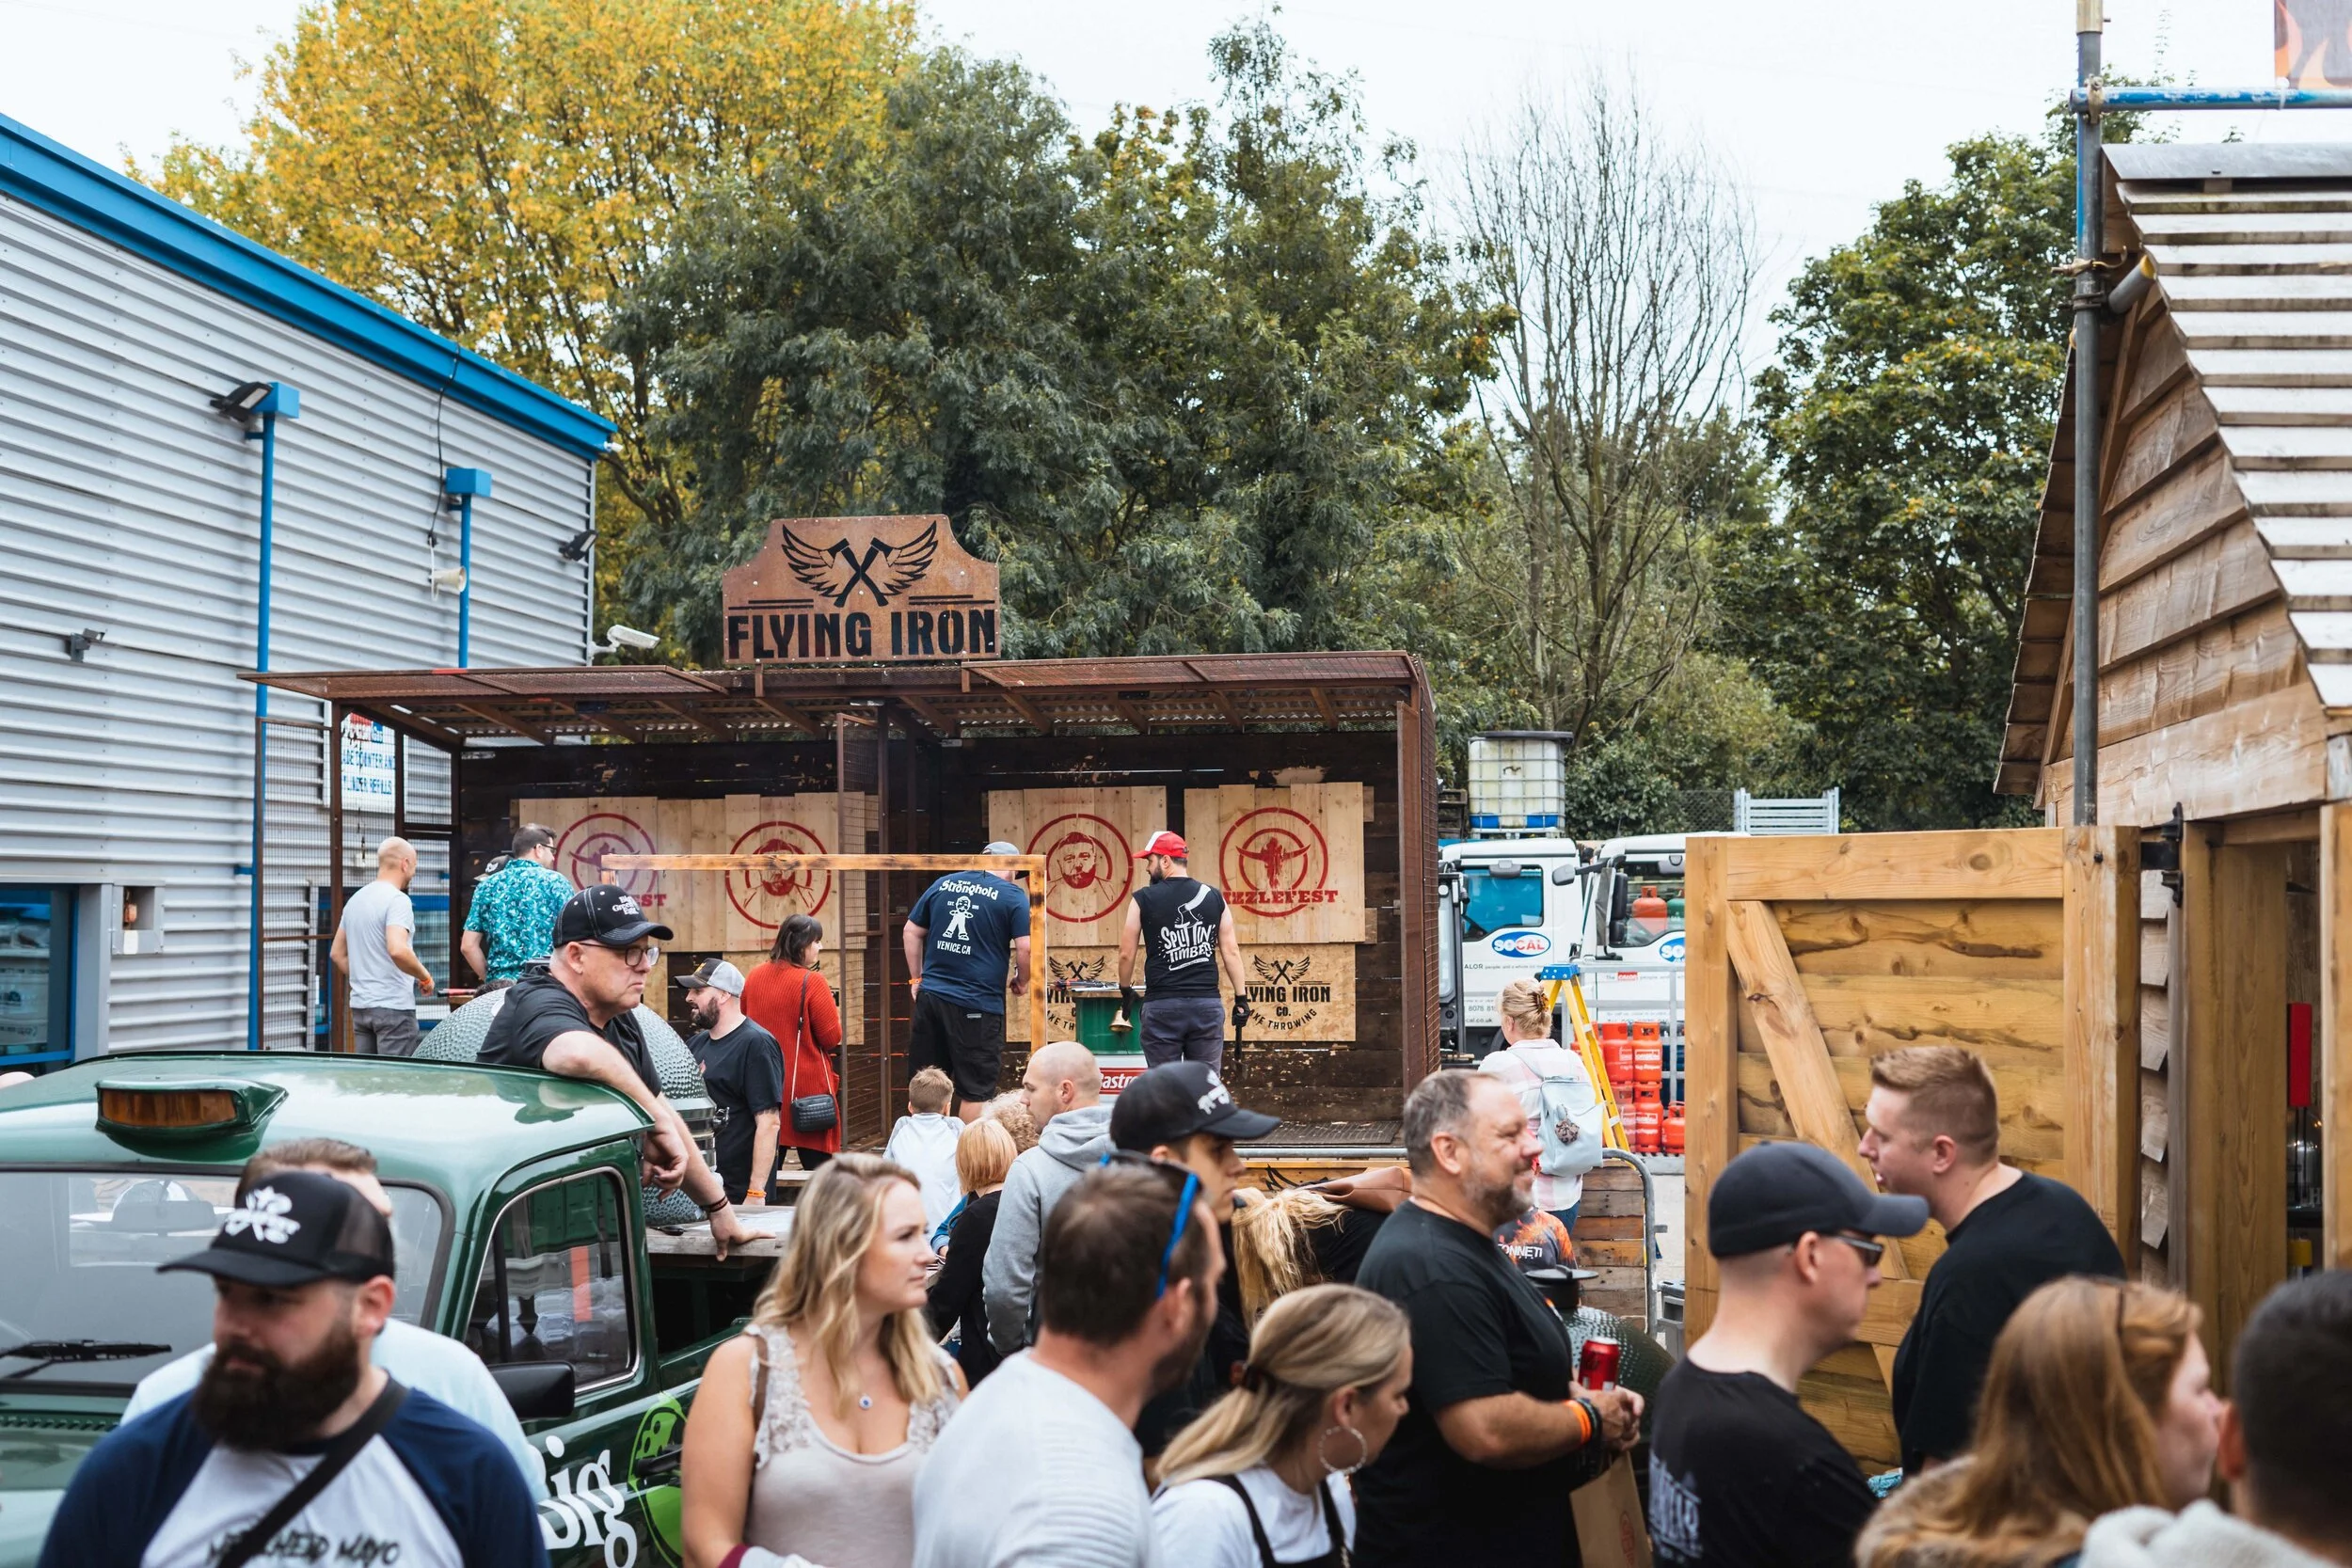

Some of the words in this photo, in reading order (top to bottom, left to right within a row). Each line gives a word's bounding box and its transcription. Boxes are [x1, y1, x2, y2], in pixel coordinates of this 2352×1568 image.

[728, 612, 873, 658] FLYING
[891, 608, 995, 656] IRON
[939, 879, 999, 900] Stronghold
[961, 944, 972, 956] CA
[1166, 942, 1213, 964] TIMBER
[1494, 939, 1545, 952] SOCAL
[1293, 987, 1331, 1003] IRON
[1268, 1007, 1317, 1031] THROWING
[1276, 1006, 1292, 1017] CO.
